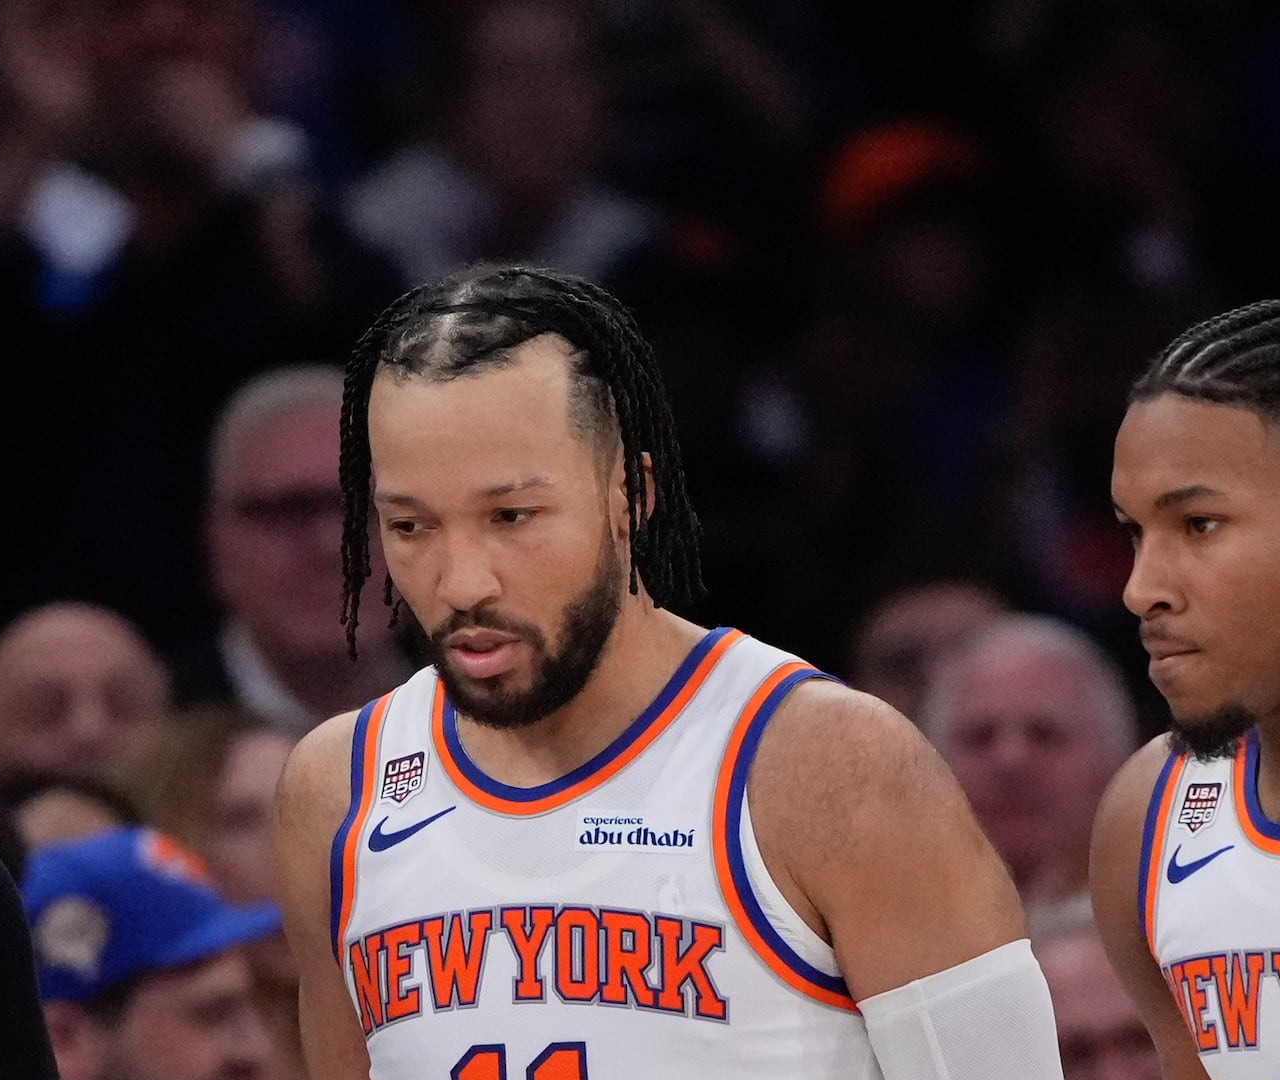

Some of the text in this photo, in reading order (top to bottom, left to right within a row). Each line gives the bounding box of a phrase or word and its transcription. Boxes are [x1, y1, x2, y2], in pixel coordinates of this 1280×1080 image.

[387, 757, 422, 776] USA
[382, 775, 422, 798] 250
[1188, 786, 1218, 800] USA
[583, 815, 644, 826] experience
[1179, 808, 1215, 824] 250
[579, 826, 695, 848] abu dhabi
[347, 903, 730, 1041] NEW YORK
